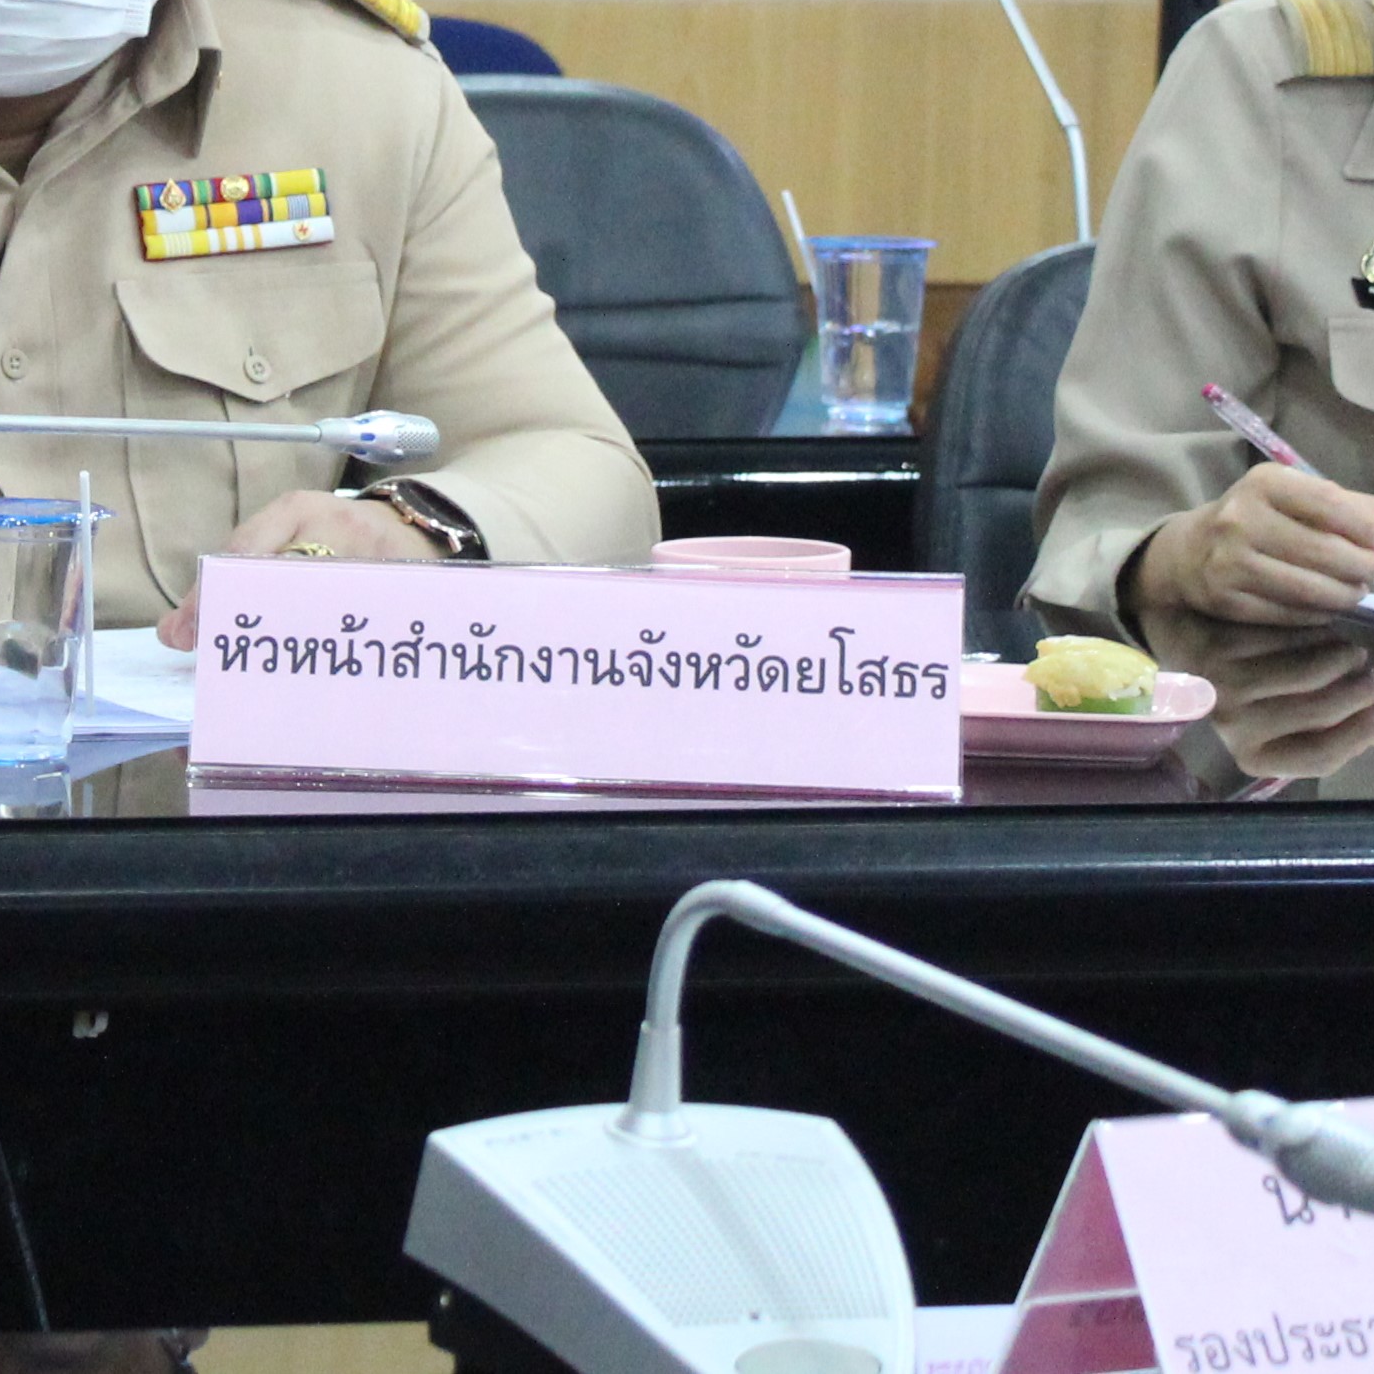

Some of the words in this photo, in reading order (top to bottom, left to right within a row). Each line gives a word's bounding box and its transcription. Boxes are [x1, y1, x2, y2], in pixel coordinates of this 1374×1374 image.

[213, 613, 951, 702] หัวหน้าสำนักงานจังหวัดยโสธร
